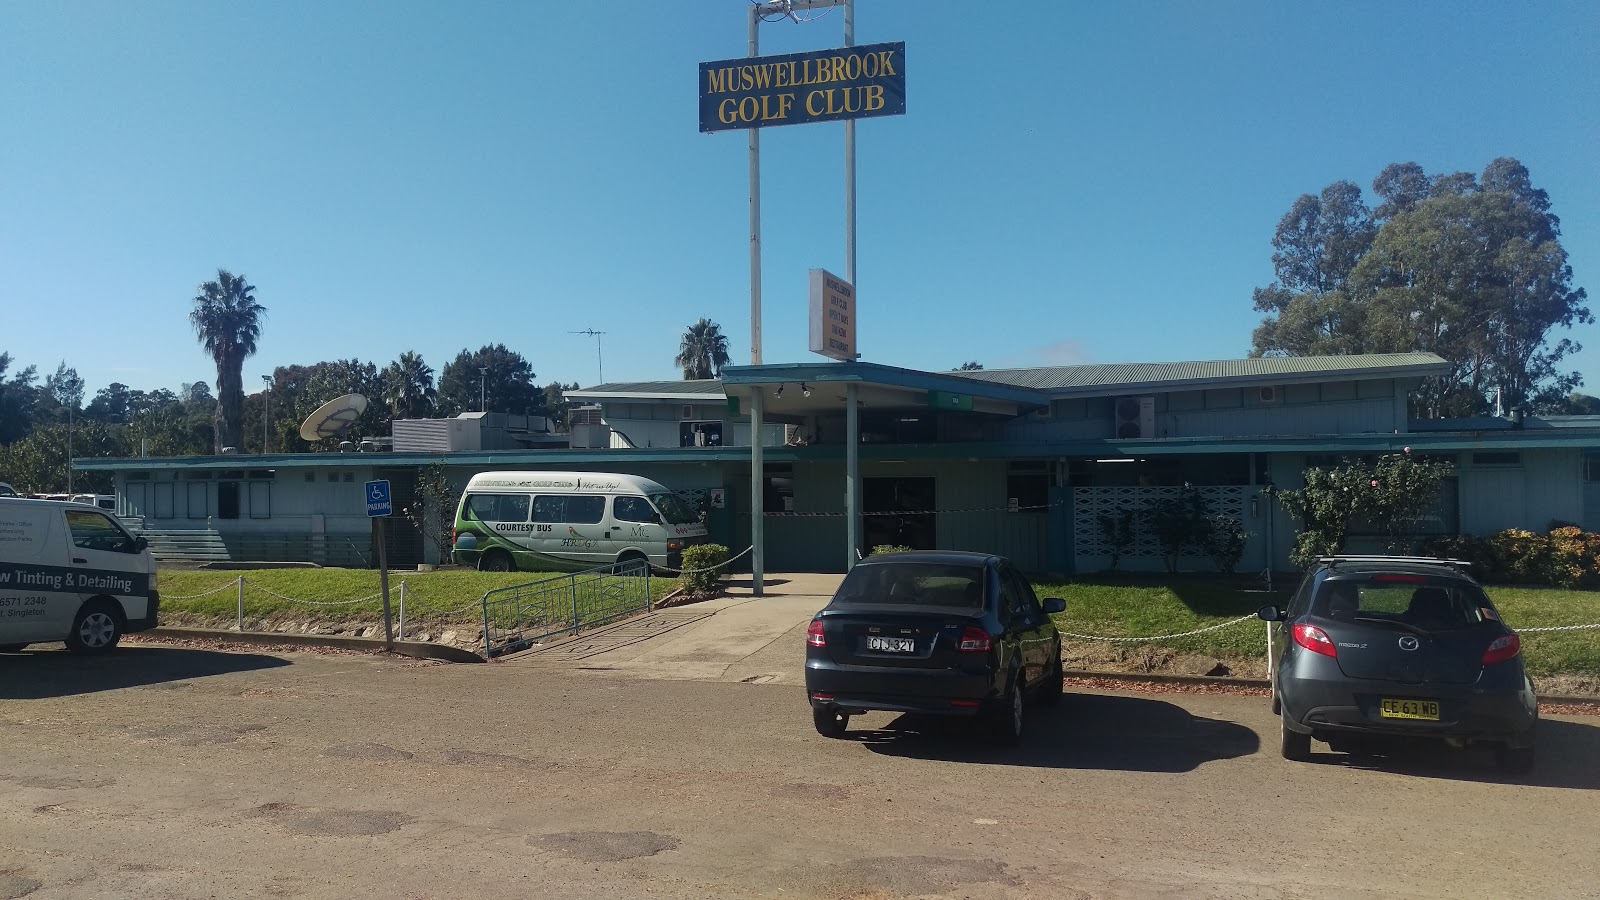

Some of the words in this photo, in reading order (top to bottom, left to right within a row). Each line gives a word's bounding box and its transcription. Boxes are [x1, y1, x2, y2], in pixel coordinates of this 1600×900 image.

[707, 51, 896, 94] MUSWELLBROOK
[718, 93, 795, 124] GOLF
[806, 85, 885, 116] CLUB
[367, 501, 390, 511] PARKING
[496, 523, 534, 532] COURTESY
[537, 524, 552, 532] BUS
[16, 570, 62, 589] Tinting
[65, 572, 75, 587] &
[78, 574, 132, 593] Detailing
[0, 597, 21, 607] 6571
[24, 596, 47, 606] 2348
[8, 608, 45, 618] Singleton
